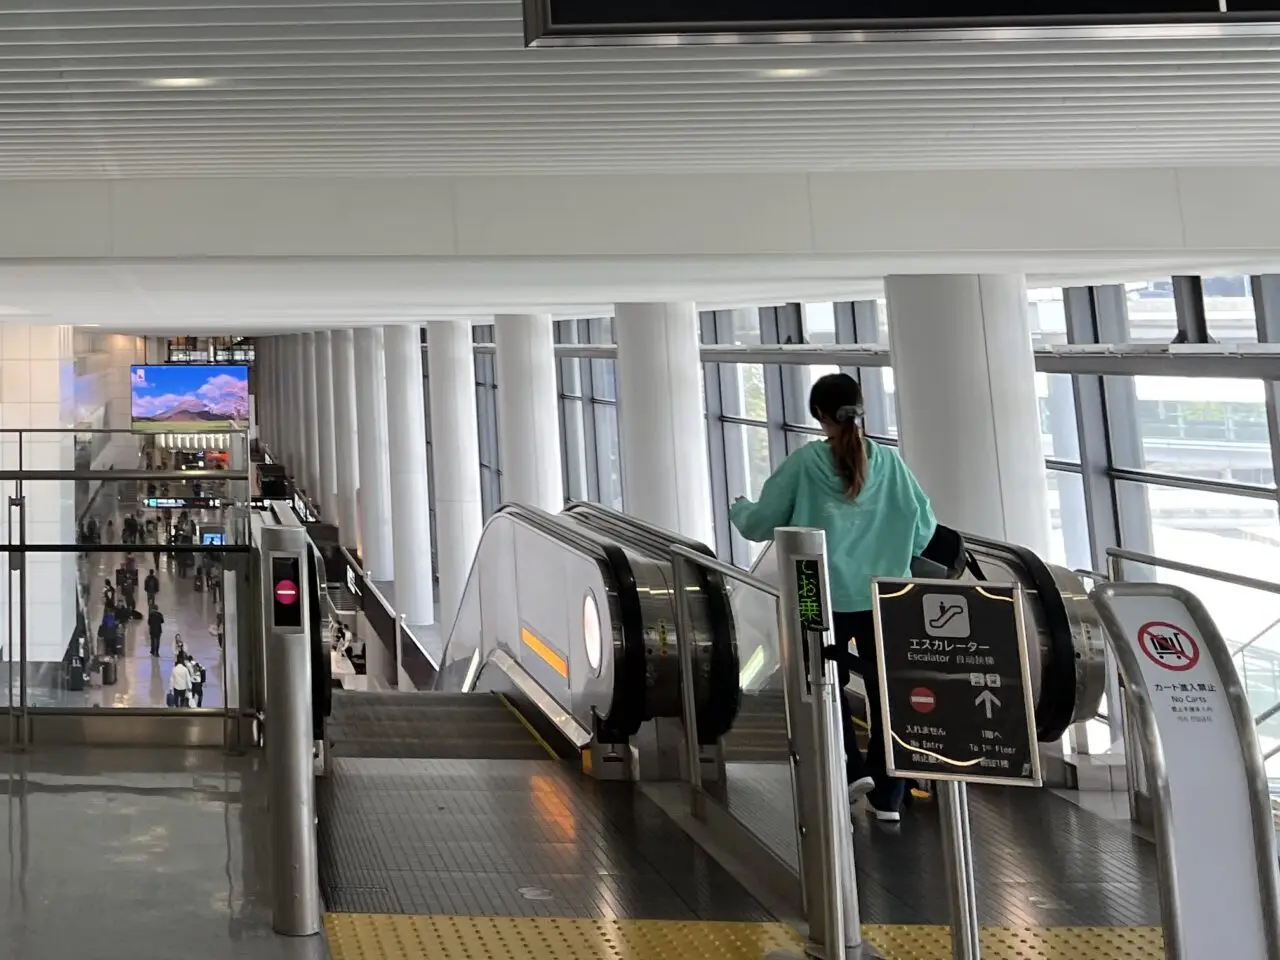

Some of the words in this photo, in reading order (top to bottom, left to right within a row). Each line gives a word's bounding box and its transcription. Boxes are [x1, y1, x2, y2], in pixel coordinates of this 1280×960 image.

[909, 639, 990, 653] エスカレーター
[907, 651, 950, 663] Escalator
